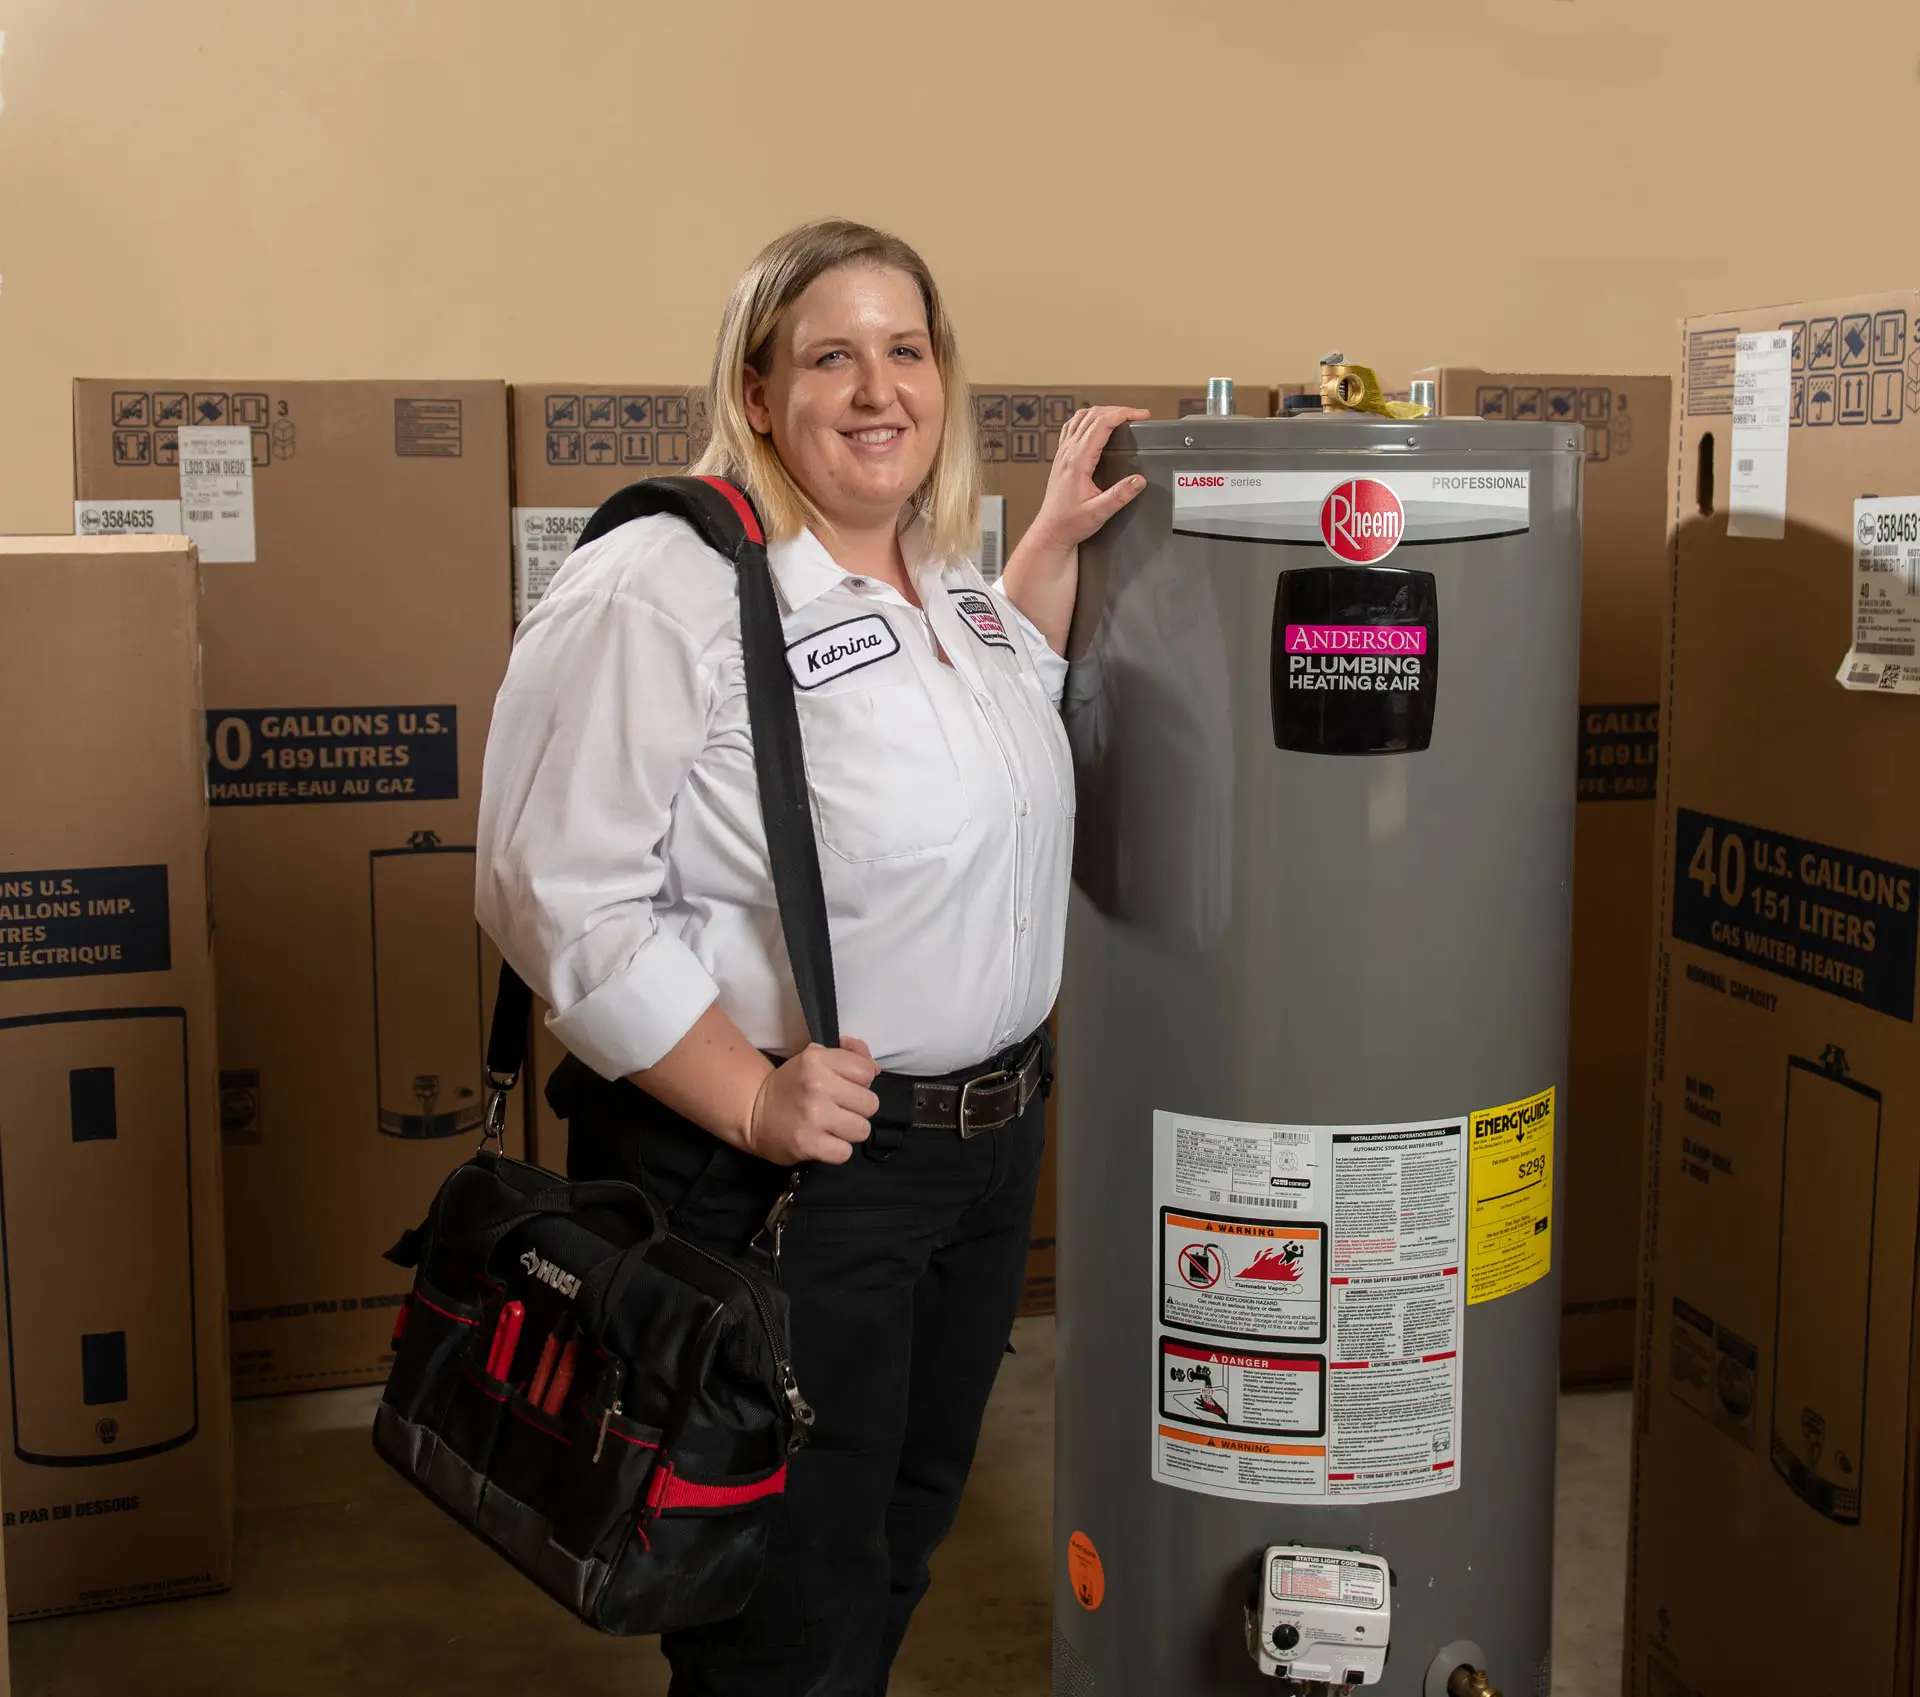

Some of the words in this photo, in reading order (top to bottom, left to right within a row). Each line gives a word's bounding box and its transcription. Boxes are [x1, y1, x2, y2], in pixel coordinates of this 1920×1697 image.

[277, 401, 289, 416] 3
[206, 461, 220, 474] SAN
[1231, 477, 1262, 487] series
[1432, 477, 1527, 489] PROFESSIONAL
[102, 510, 154, 528] 3584635
[1331, 480, 1399, 550] Rheem
[546, 517, 588, 534] 358463
[1877, 513, 1920, 543] 358463
[1291, 627, 1422, 651] ANDERSON
[807, 633, 882, 673] Katrina
[1289, 656, 1421, 675] PLUMBING
[1289, 675, 1372, 690] HEATING
[261, 714, 389, 738] GALLONS
[399, 712, 449, 735] U.S.
[215, 716, 252, 771] 0
[261, 748, 315, 769] 189
[319, 745, 411, 769] LITRES
[210, 780, 336, 799] HAUFFE-EAU
[342, 779, 369, 795] AU
[376, 778, 416, 794] GAZ
[1688, 826, 1746, 908] 40
[1753, 839, 1794, 880] U.S.
[1800, 852, 1911, 913] GALLONS
[0, 880, 34, 898] NS
[40, 879, 80, 896] U.S.
[89, 899, 136, 916] IMP.
[1751, 886, 1791, 925] 151
[1800, 901, 1876, 952] LITERS
[1711, 920, 1741, 947] GAS
[1744, 931, 1797, 968] WATER
[1801, 950, 1865, 994] HEATER
[1730, 979, 1779, 1013] CAPACITY
[1476, 1098, 1551, 1138] ENERGYGUIDE
[1399, 1132, 1426, 1140] OPERATION
[1519, 1155, 1546, 1179] $293
[1219, 1224, 1275, 1237] WARNING
[1235, 1283, 1267, 1291] Flammable
[1256, 1299, 1278, 1307] HAZARD
[1222, 1356, 1269, 1368] DANGER
[1221, 1440, 1270, 1454] WARNING
[20, 1508, 49, 1524] PAR
[53, 1504, 72, 1521] EN
[76, 1496, 140, 1518] DESSOUS
